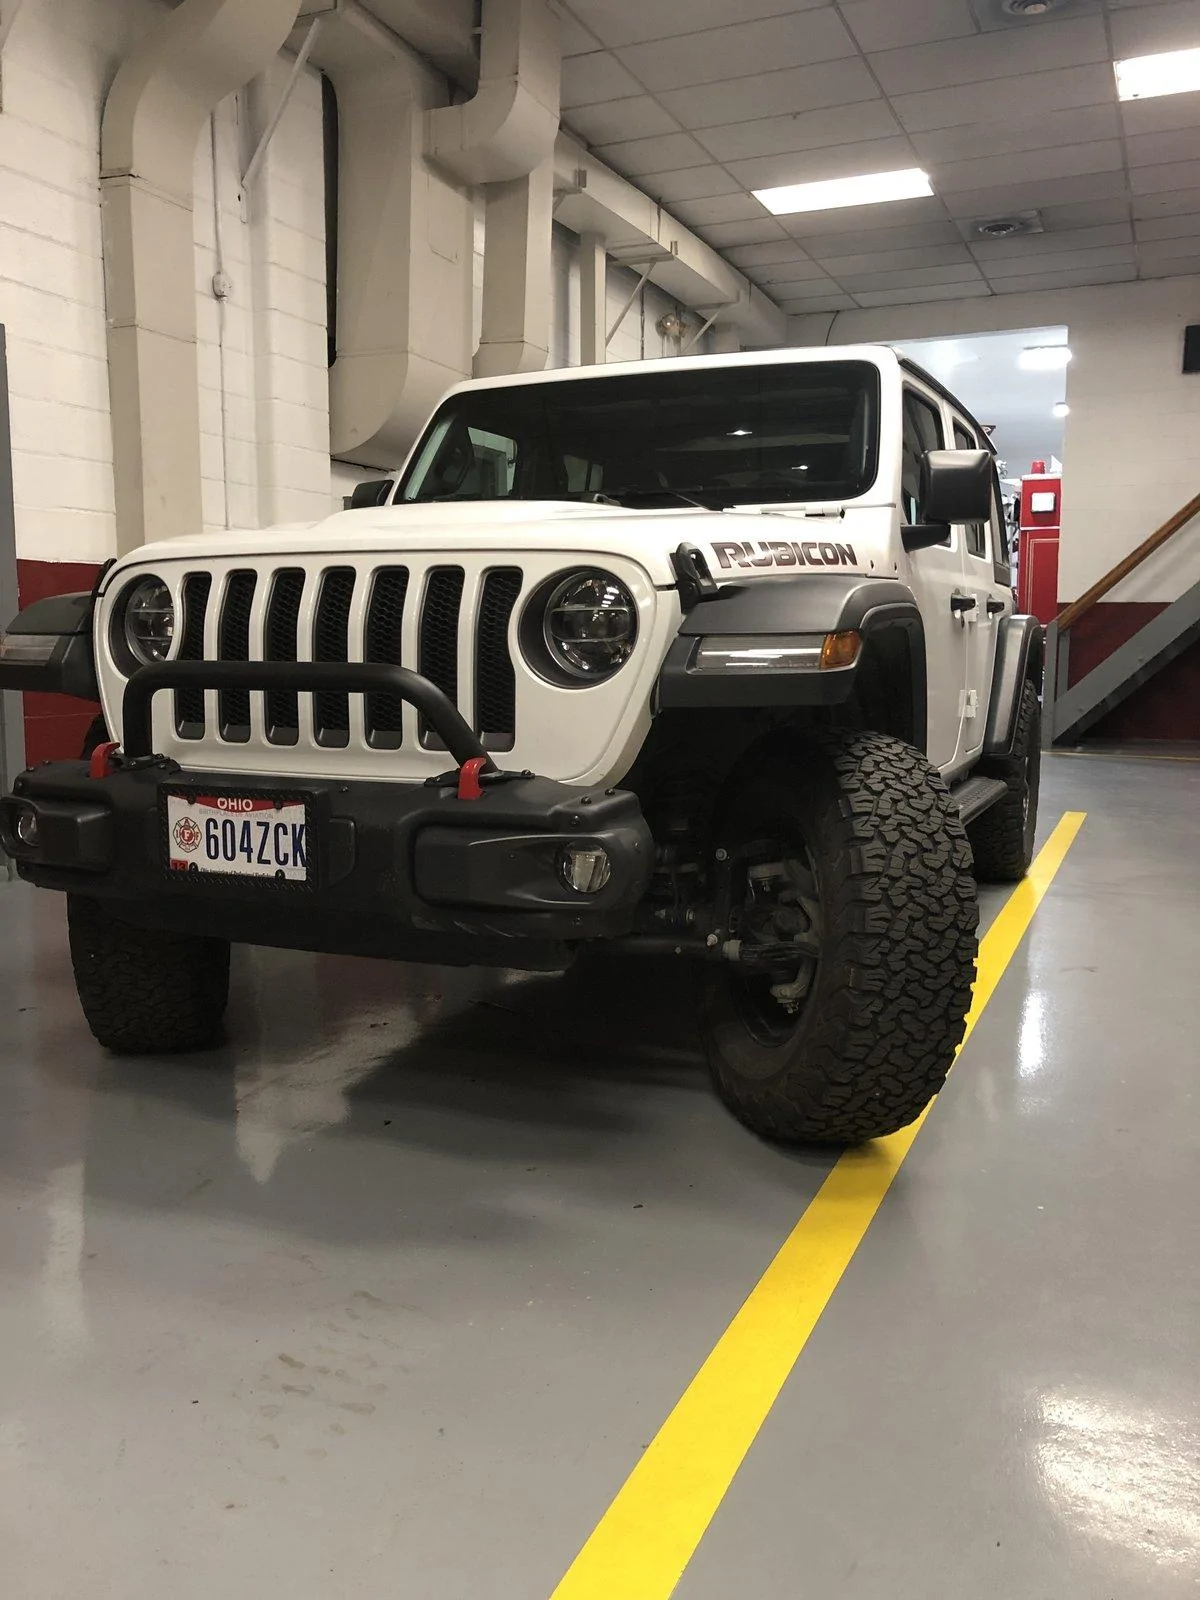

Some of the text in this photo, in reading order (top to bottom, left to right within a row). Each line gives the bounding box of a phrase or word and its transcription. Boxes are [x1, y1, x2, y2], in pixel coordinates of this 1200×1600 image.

[710, 541, 858, 569] RUBICON
[217, 797, 253, 811] OHIO
[205, 817, 307, 868] 604ZCK
